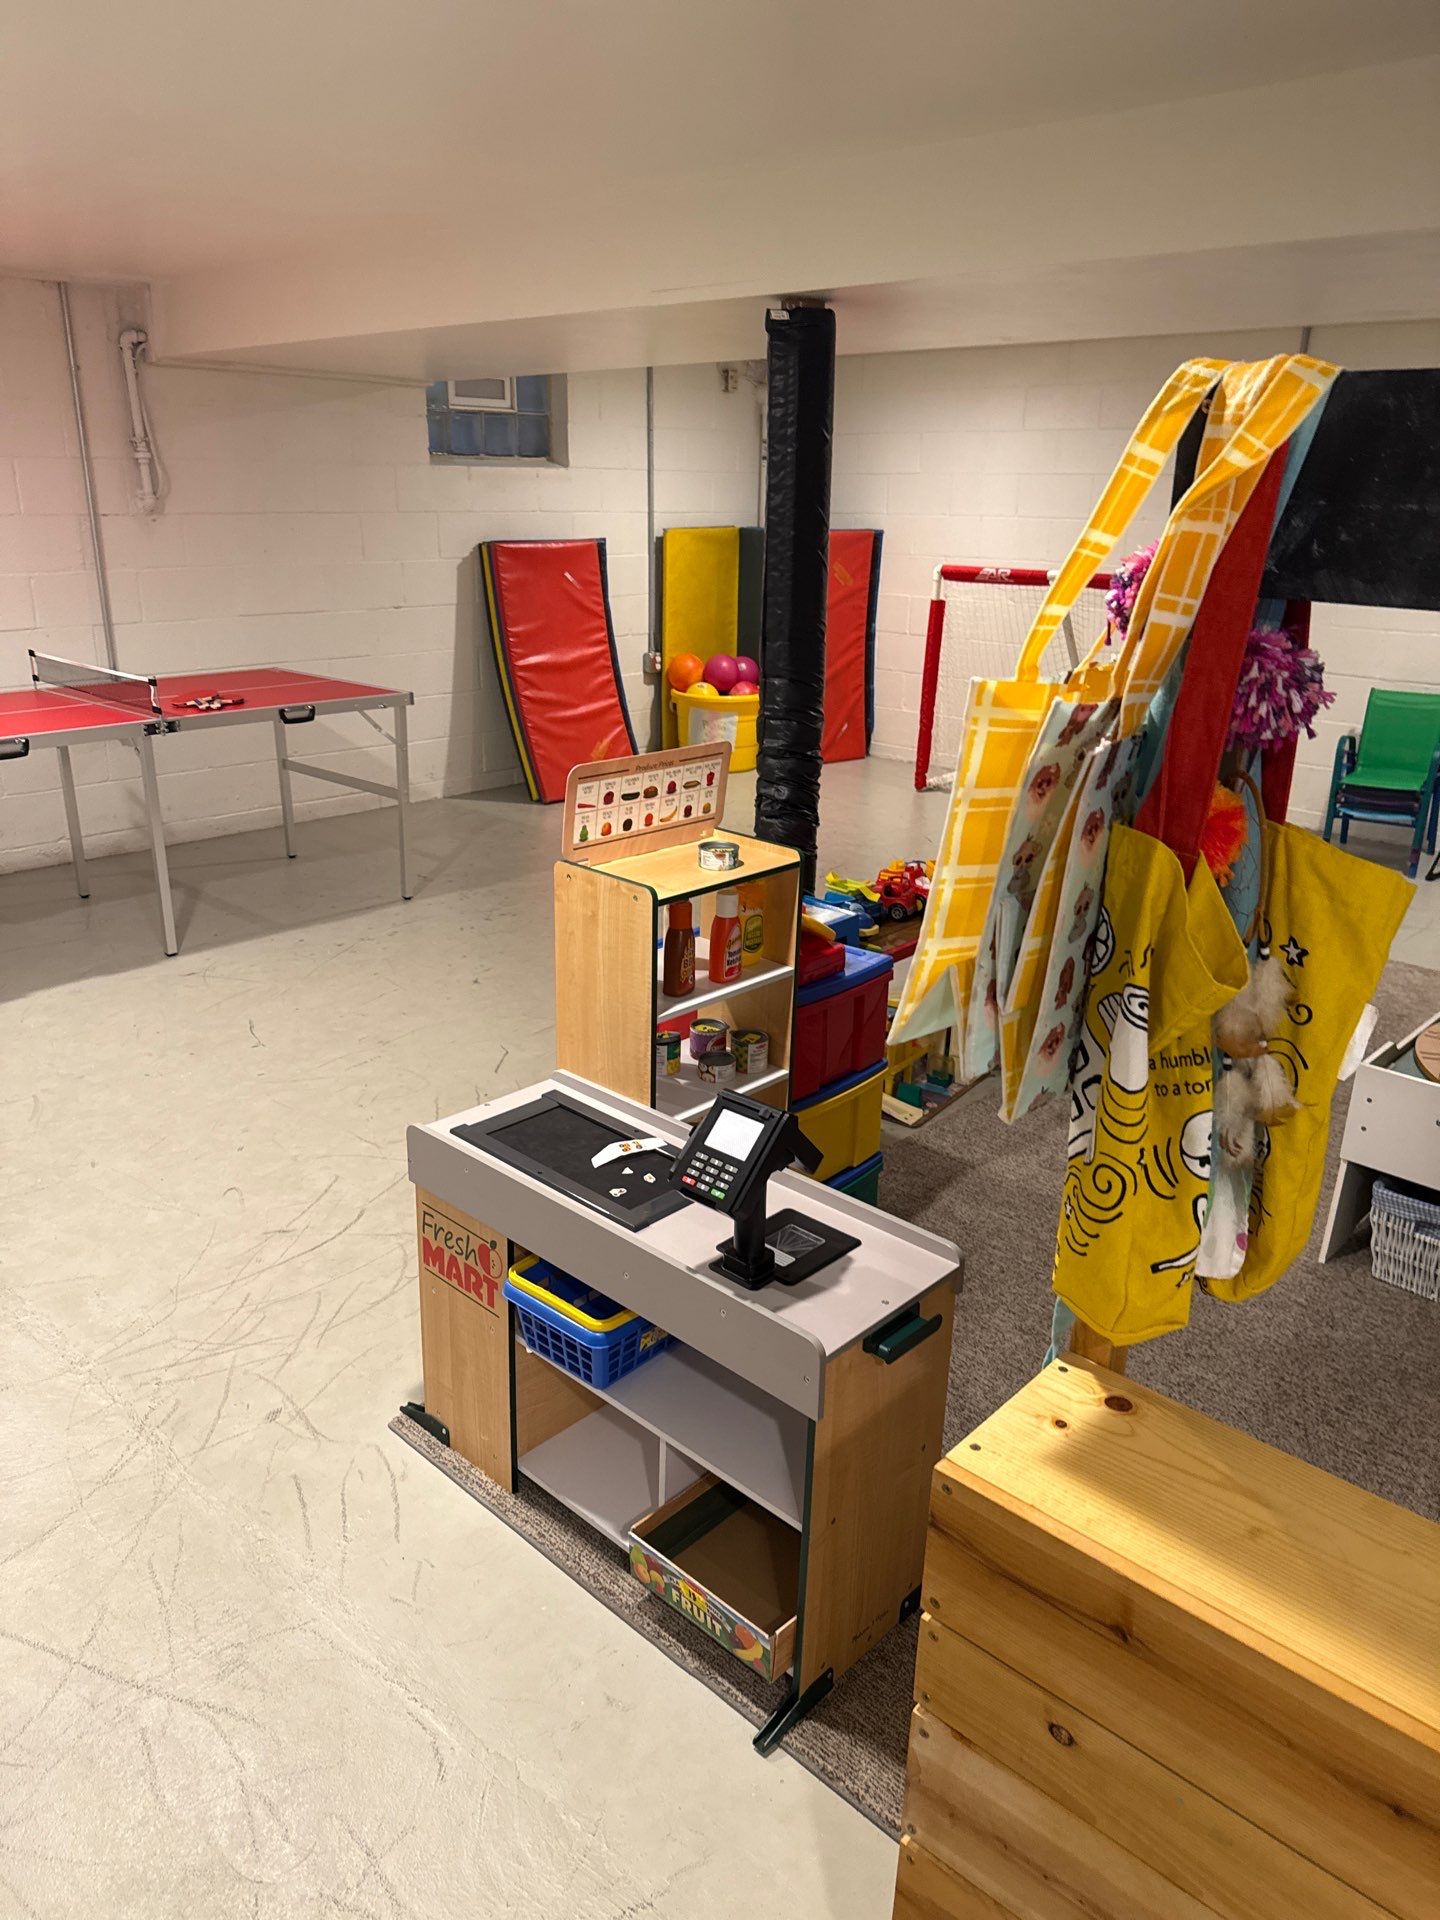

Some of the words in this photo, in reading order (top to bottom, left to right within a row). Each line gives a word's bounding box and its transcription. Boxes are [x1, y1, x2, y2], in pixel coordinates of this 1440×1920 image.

[1149, 1059, 1156, 1070] a
[1160, 1047, 1211, 1068] humbl
[1155, 1083, 1168, 1097] to
[1172, 1084, 1180, 1096] a
[1185, 1080, 1211, 1095] tor
[421, 1210, 479, 1266] Fresh
[422, 1236, 498, 1309] MART
[671, 1587, 723, 1637] FRUIT
